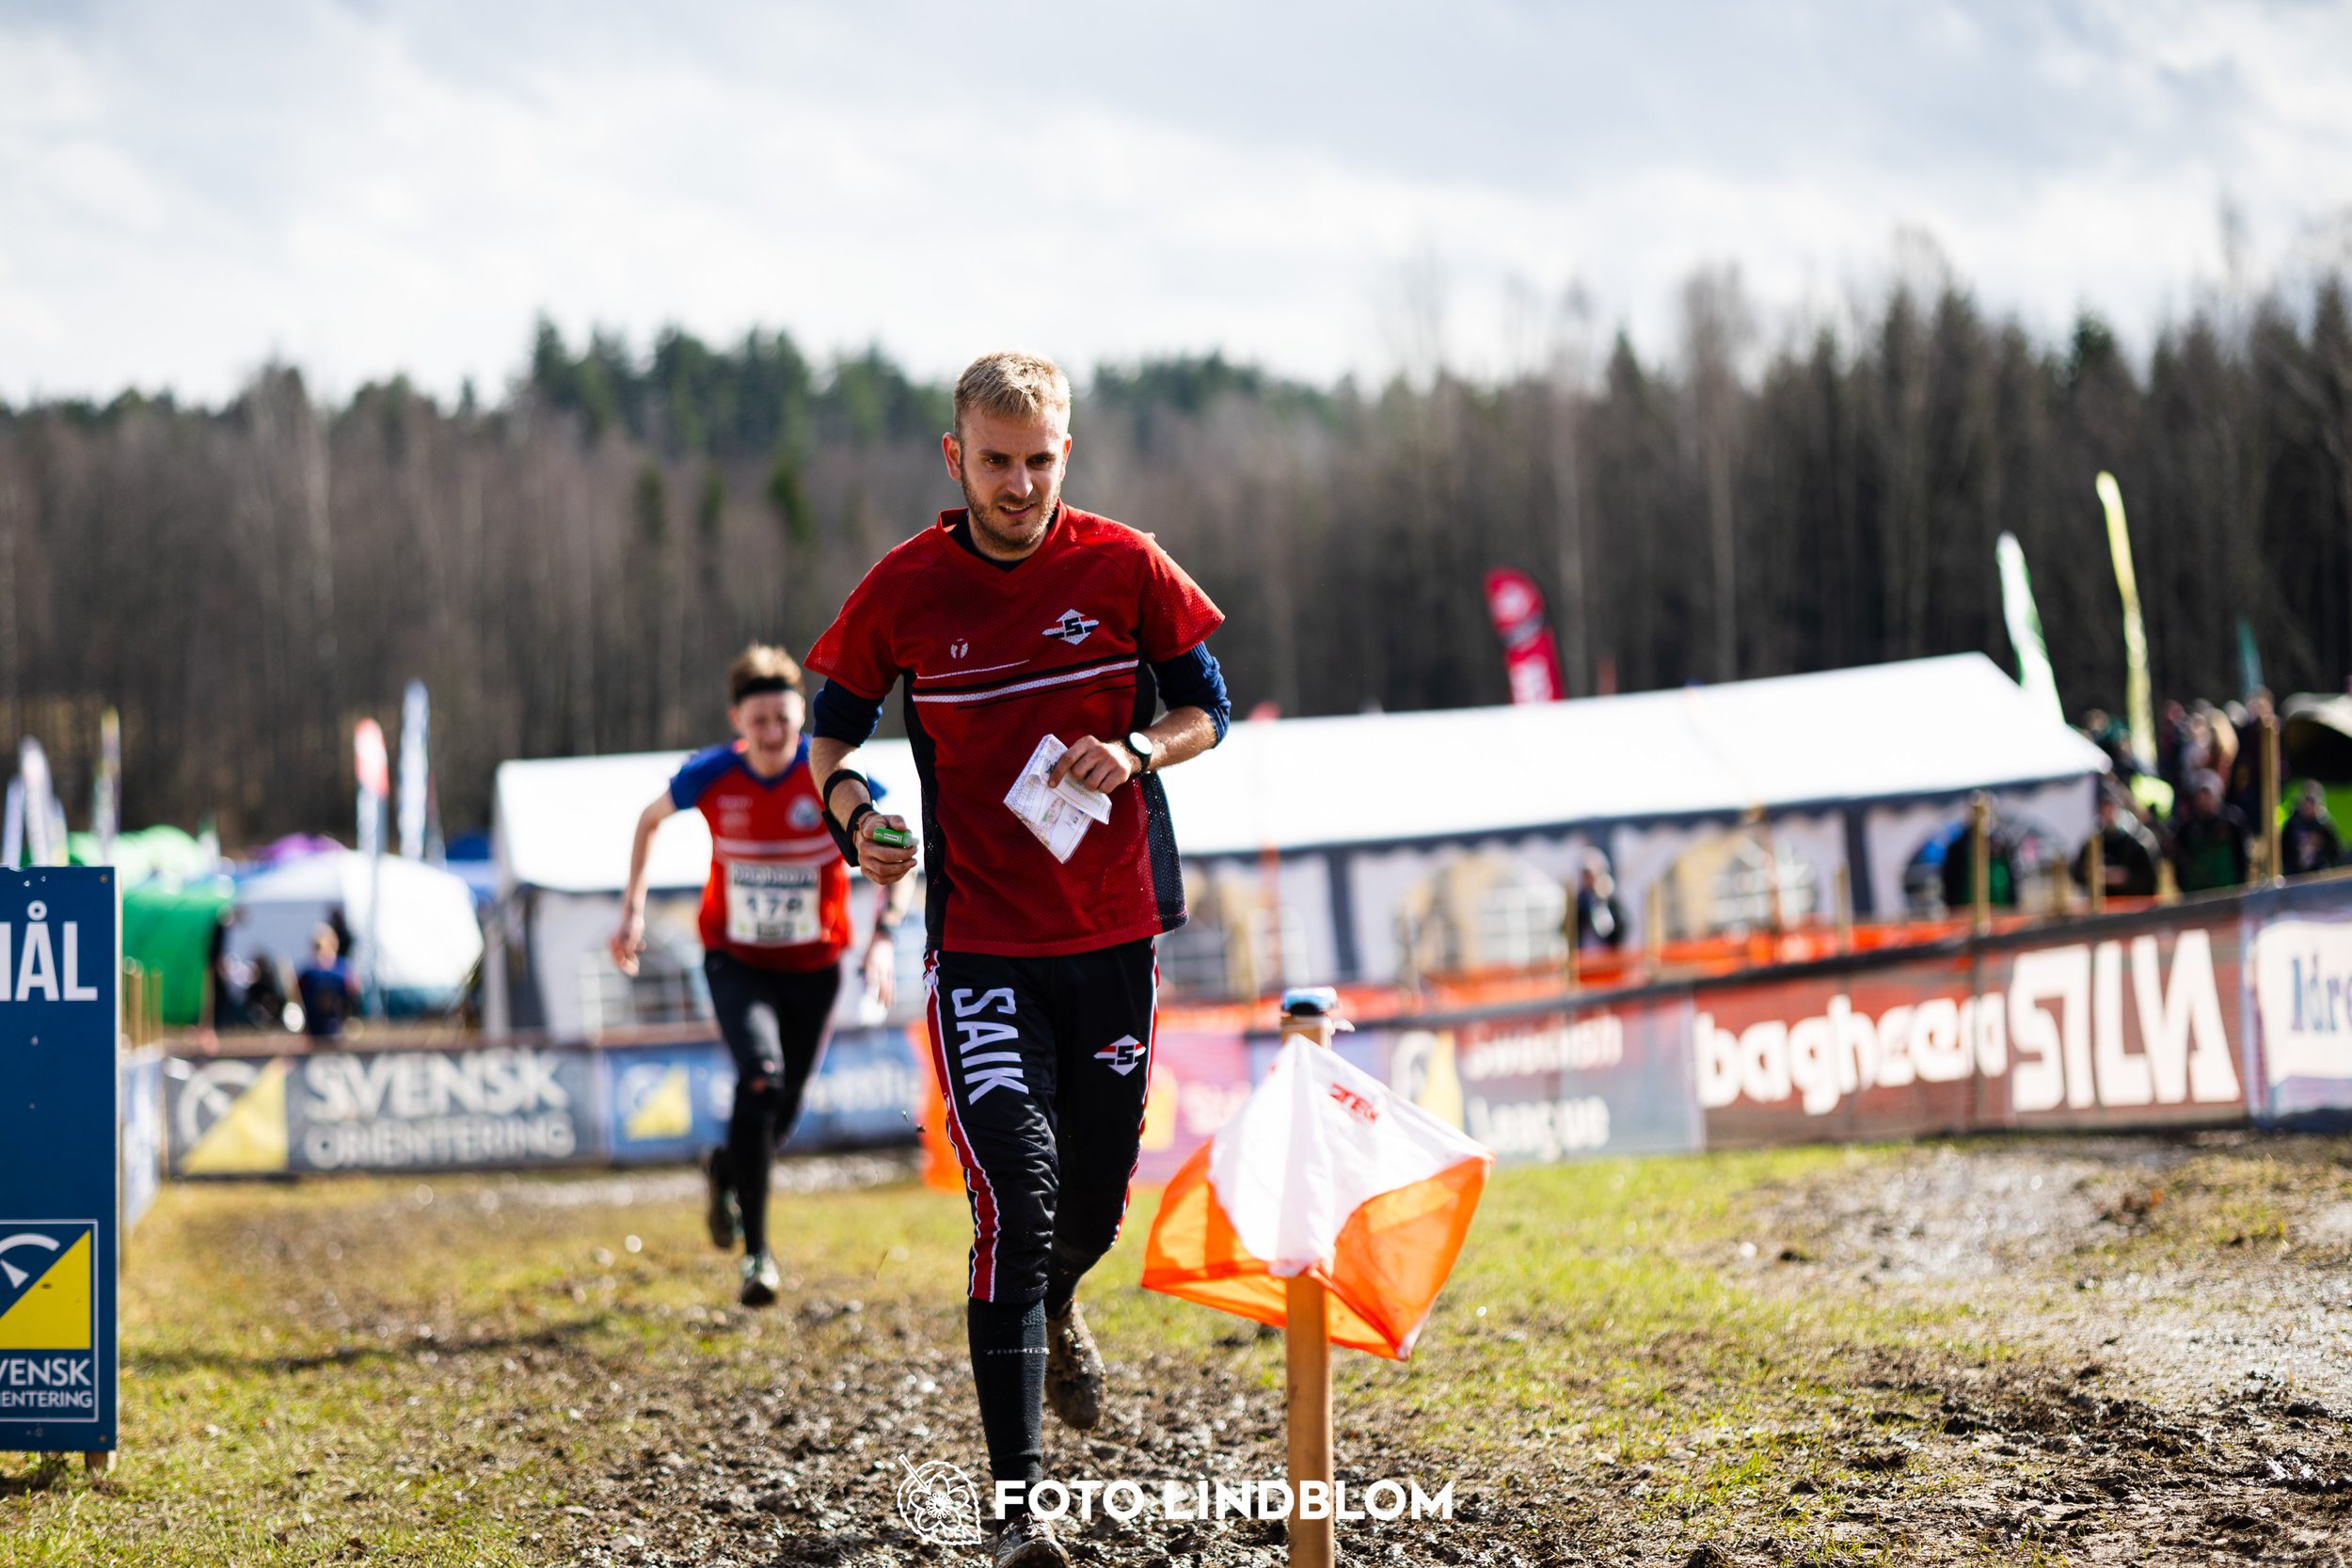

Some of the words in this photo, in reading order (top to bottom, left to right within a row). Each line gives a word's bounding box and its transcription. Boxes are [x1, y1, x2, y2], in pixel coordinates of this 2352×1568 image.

[2010, 927, 2242, 1113] SILVA
[2290, 952, 2352, 1033] Idr
[304, 1046, 569, 1120] SVENSK
[951, 987, 1029, 1106] SAIK
[0, 1389, 93, 1408] ENTERING
